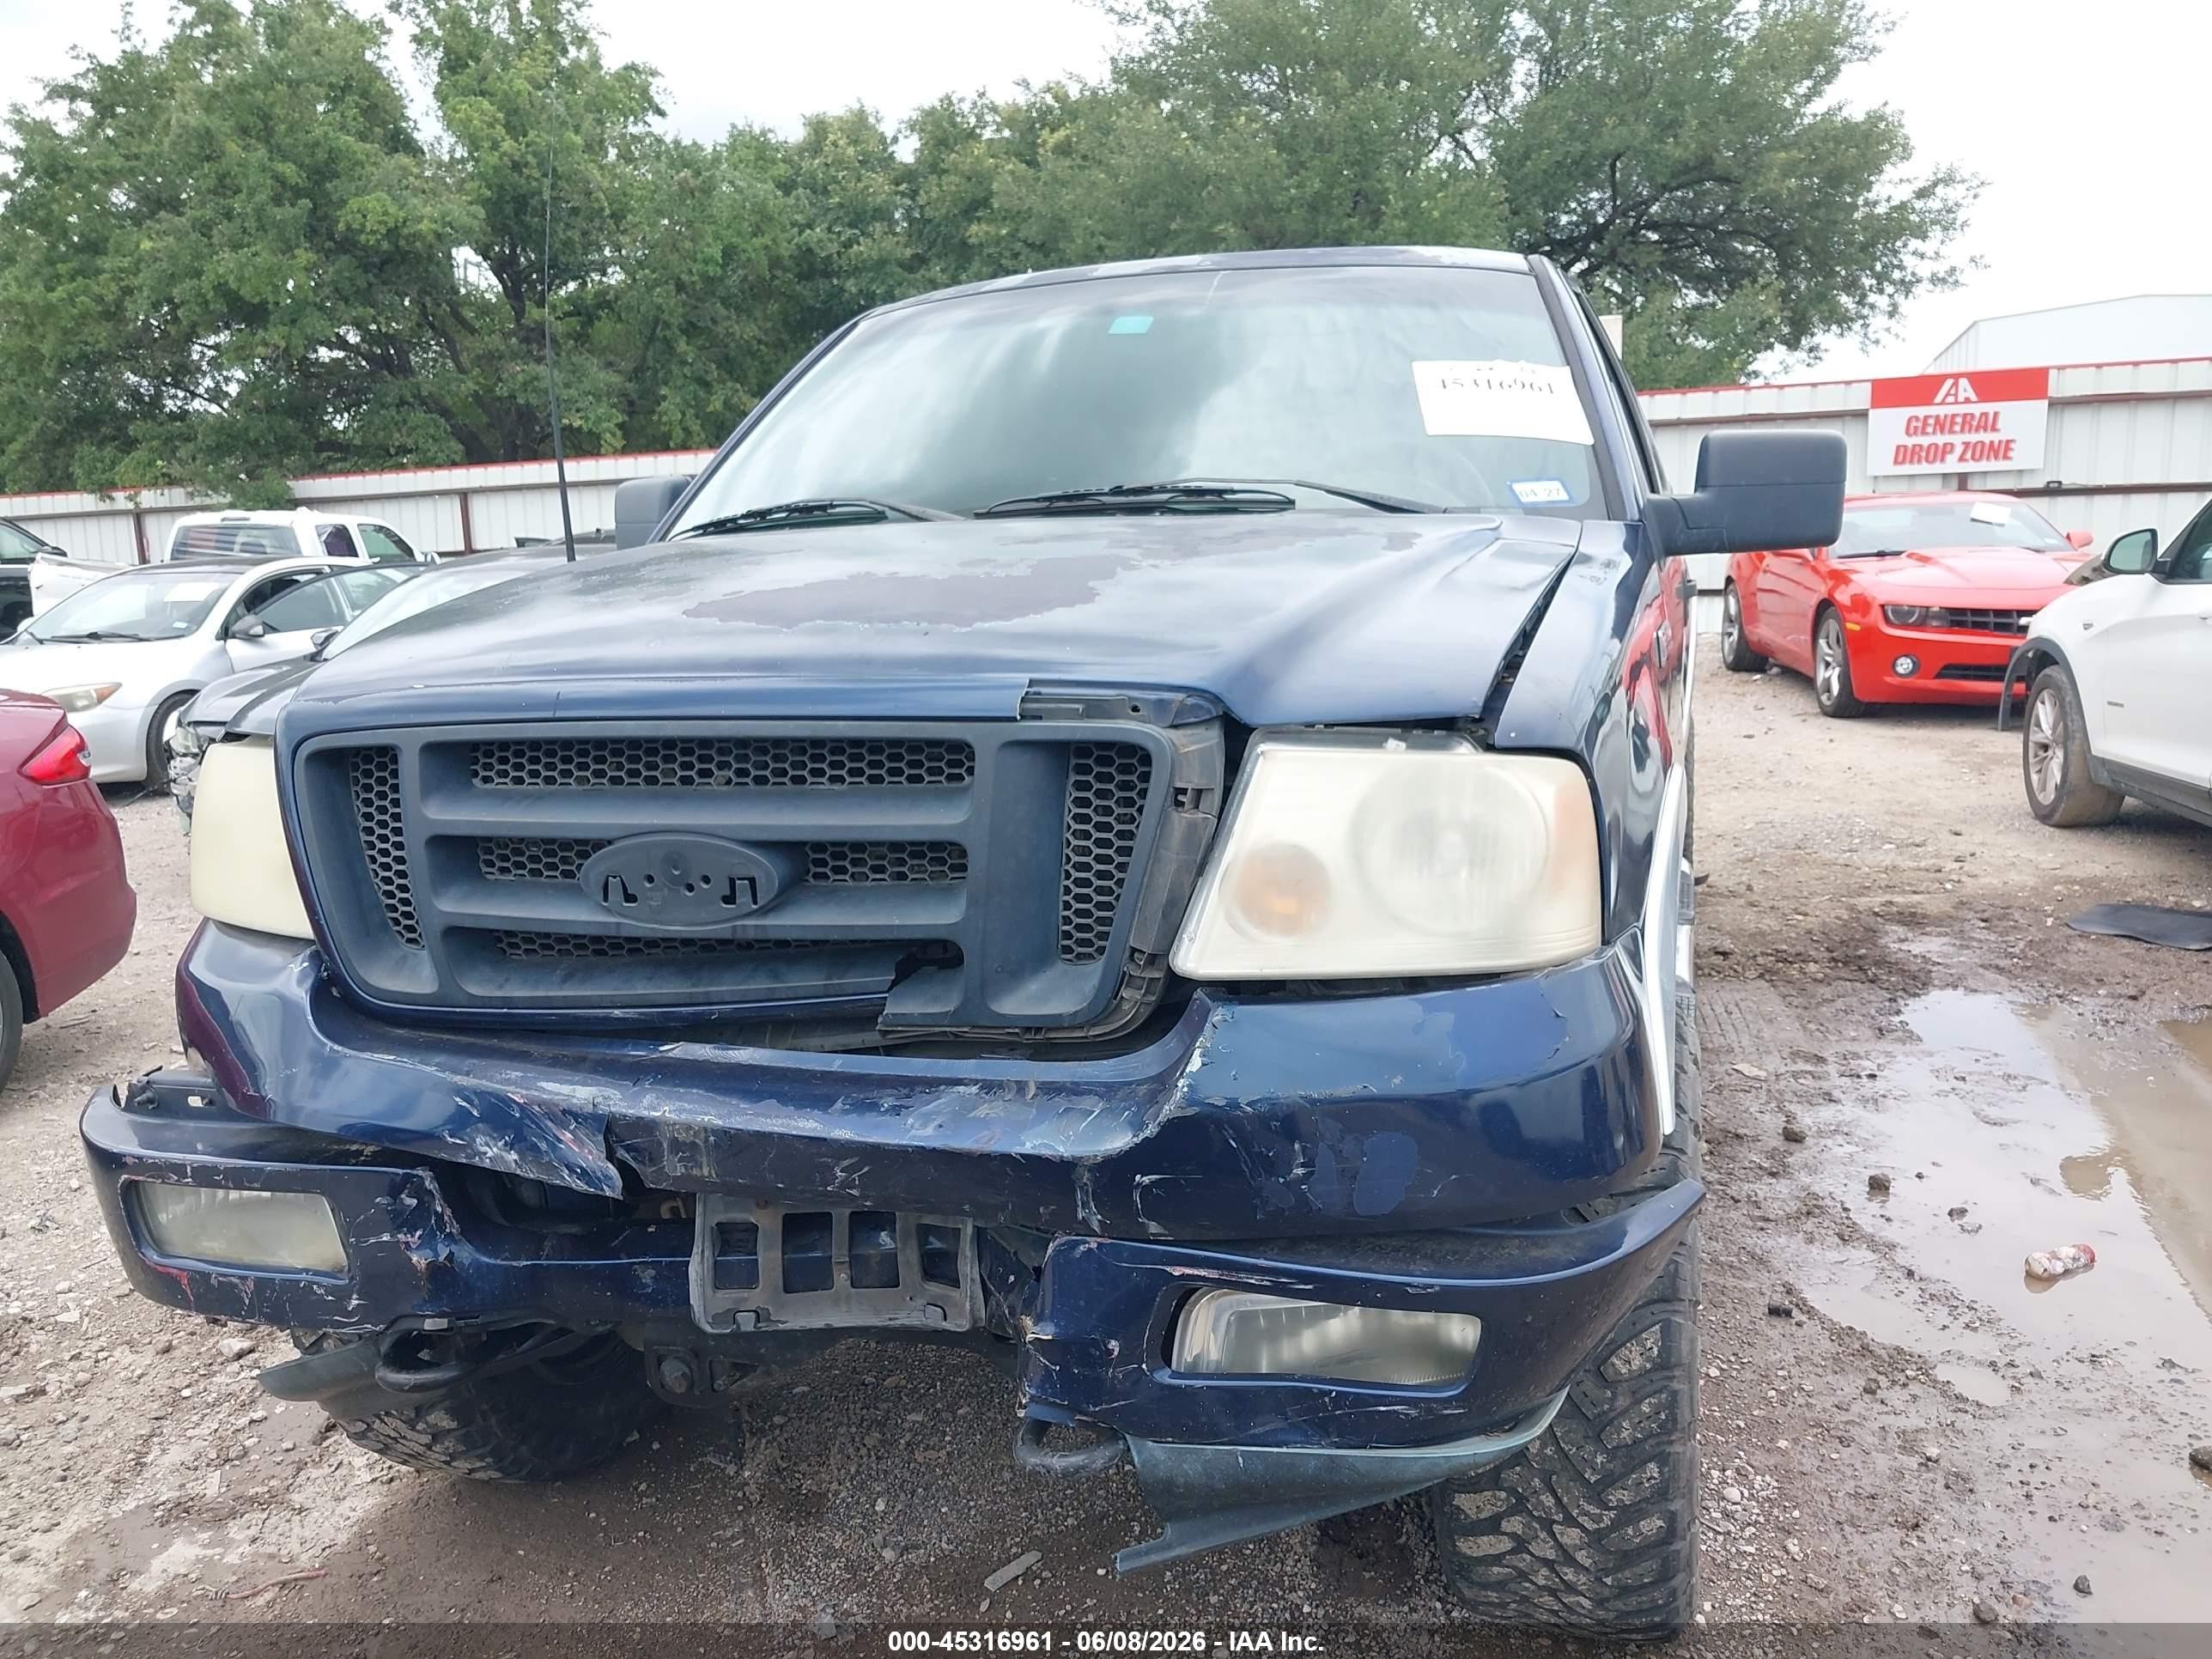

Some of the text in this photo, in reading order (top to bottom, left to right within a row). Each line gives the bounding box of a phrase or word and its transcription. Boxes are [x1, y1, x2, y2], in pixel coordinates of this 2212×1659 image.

[1905, 411, 2001, 438] GENERAL
[1893, 439, 2016, 465] DROP ZONE
